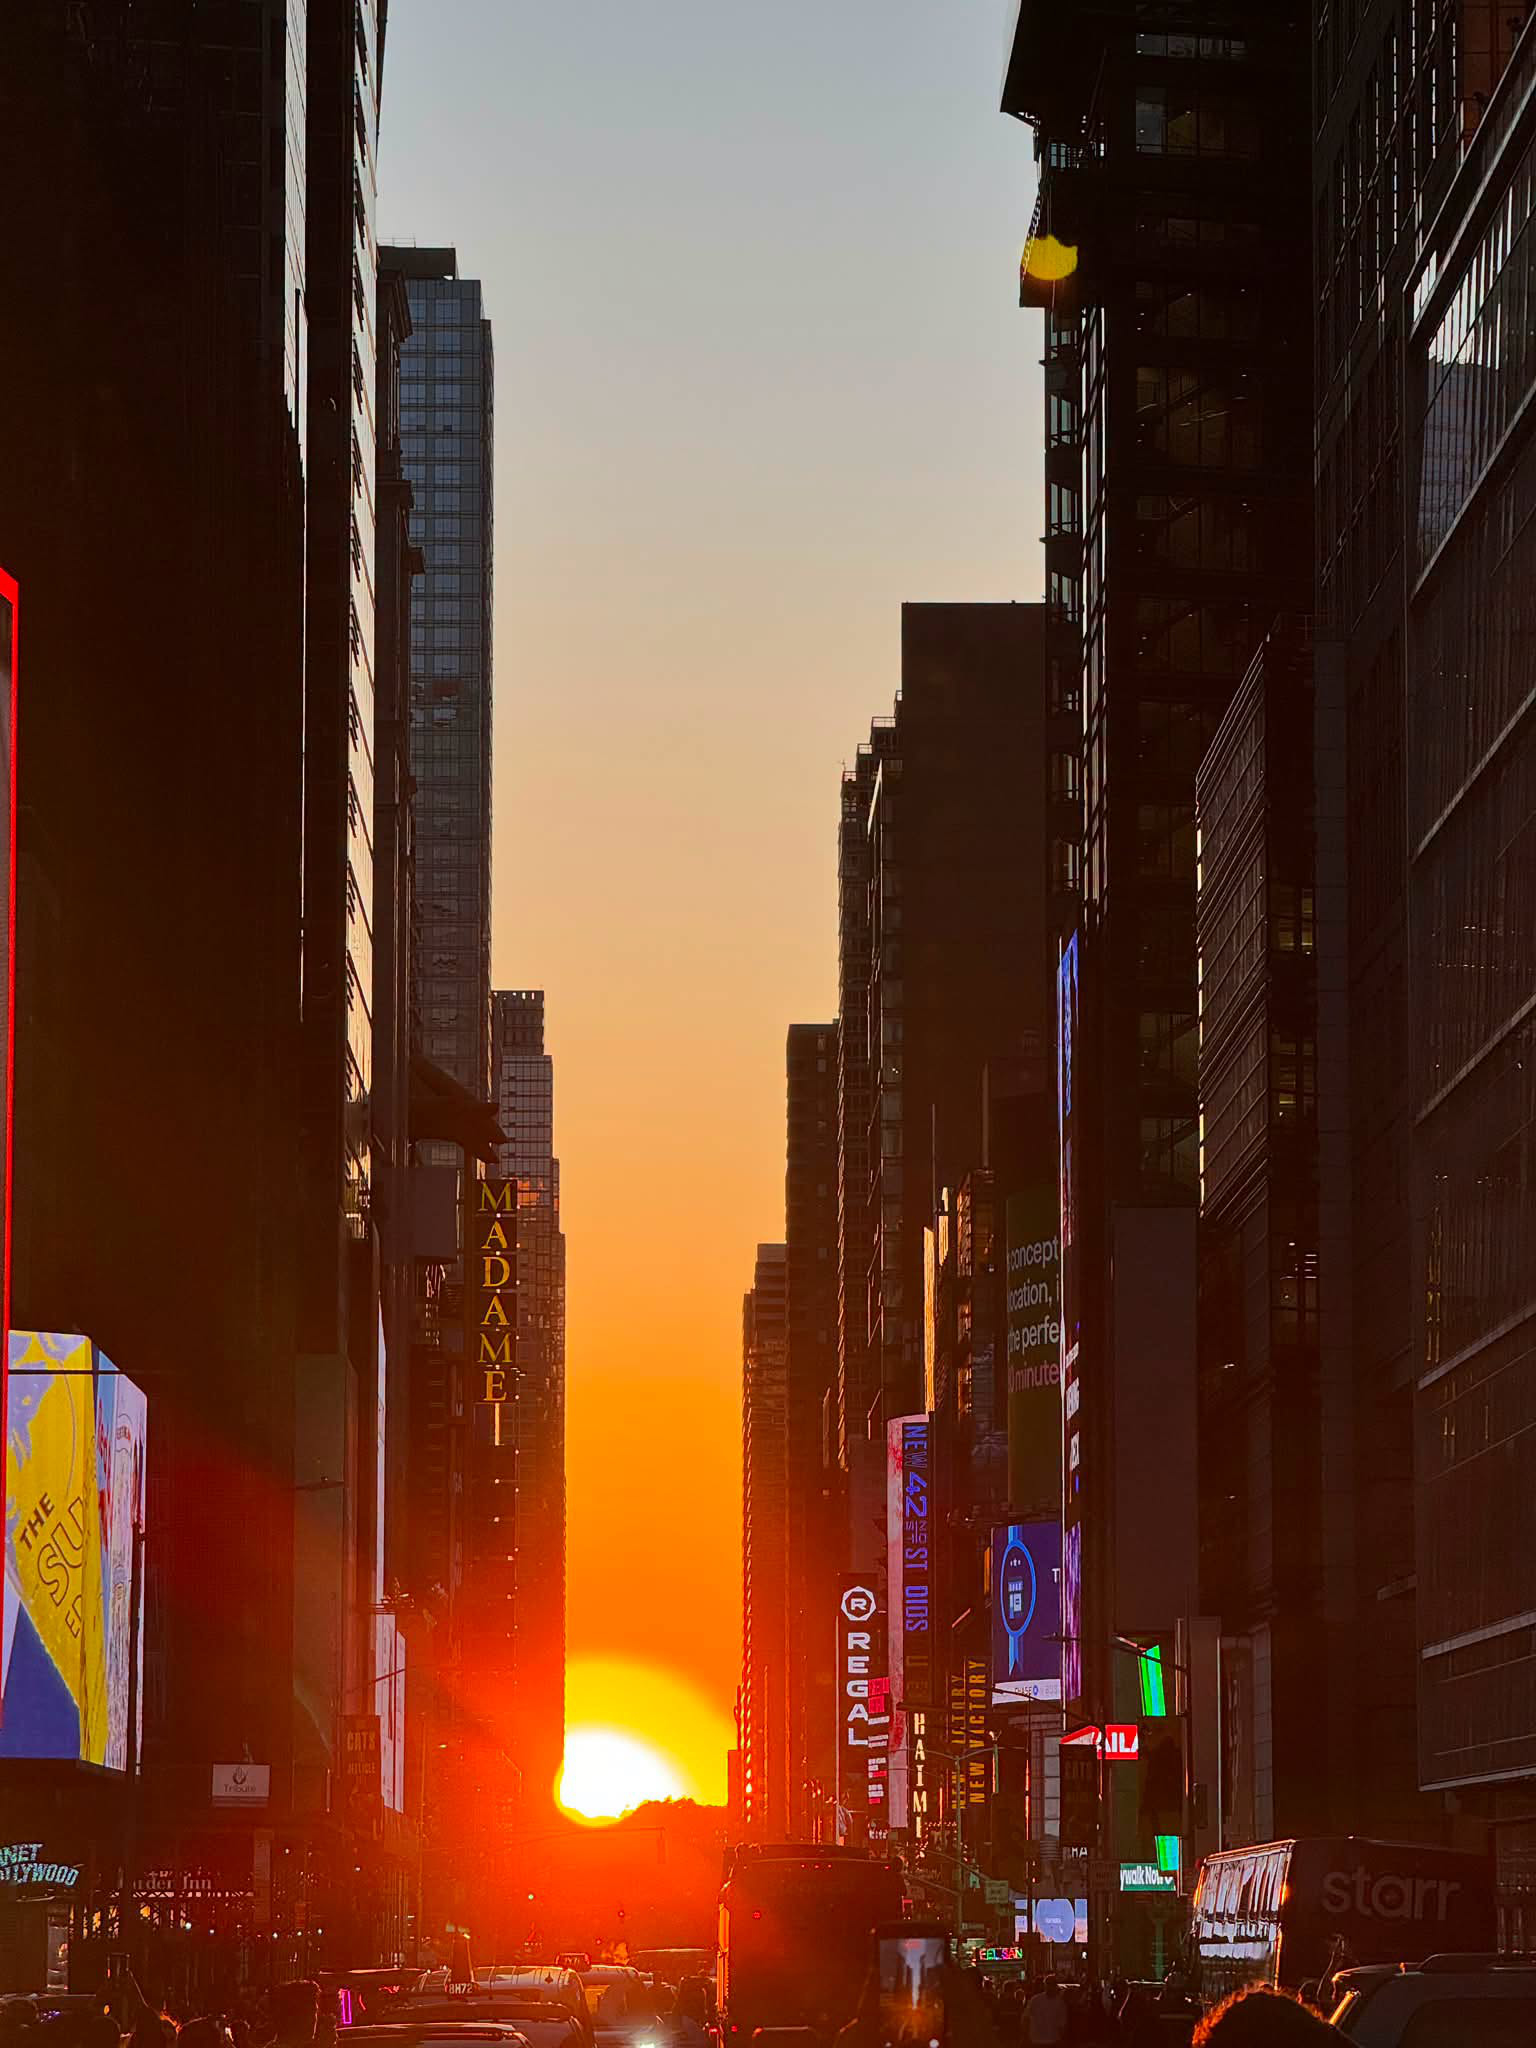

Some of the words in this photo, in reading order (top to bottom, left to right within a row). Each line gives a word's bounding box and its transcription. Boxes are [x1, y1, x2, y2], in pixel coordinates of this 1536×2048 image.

[478, 1181, 514, 1402] MADAME
[904, 1425, 928, 1468] NEW
[20, 1492, 55, 1551] THE
[846, 1632, 872, 1746] REGAL
[968, 1659, 987, 1749] VICTORY
[969, 1762, 986, 1805] NEW
[1322, 1865, 1466, 1921] starr
